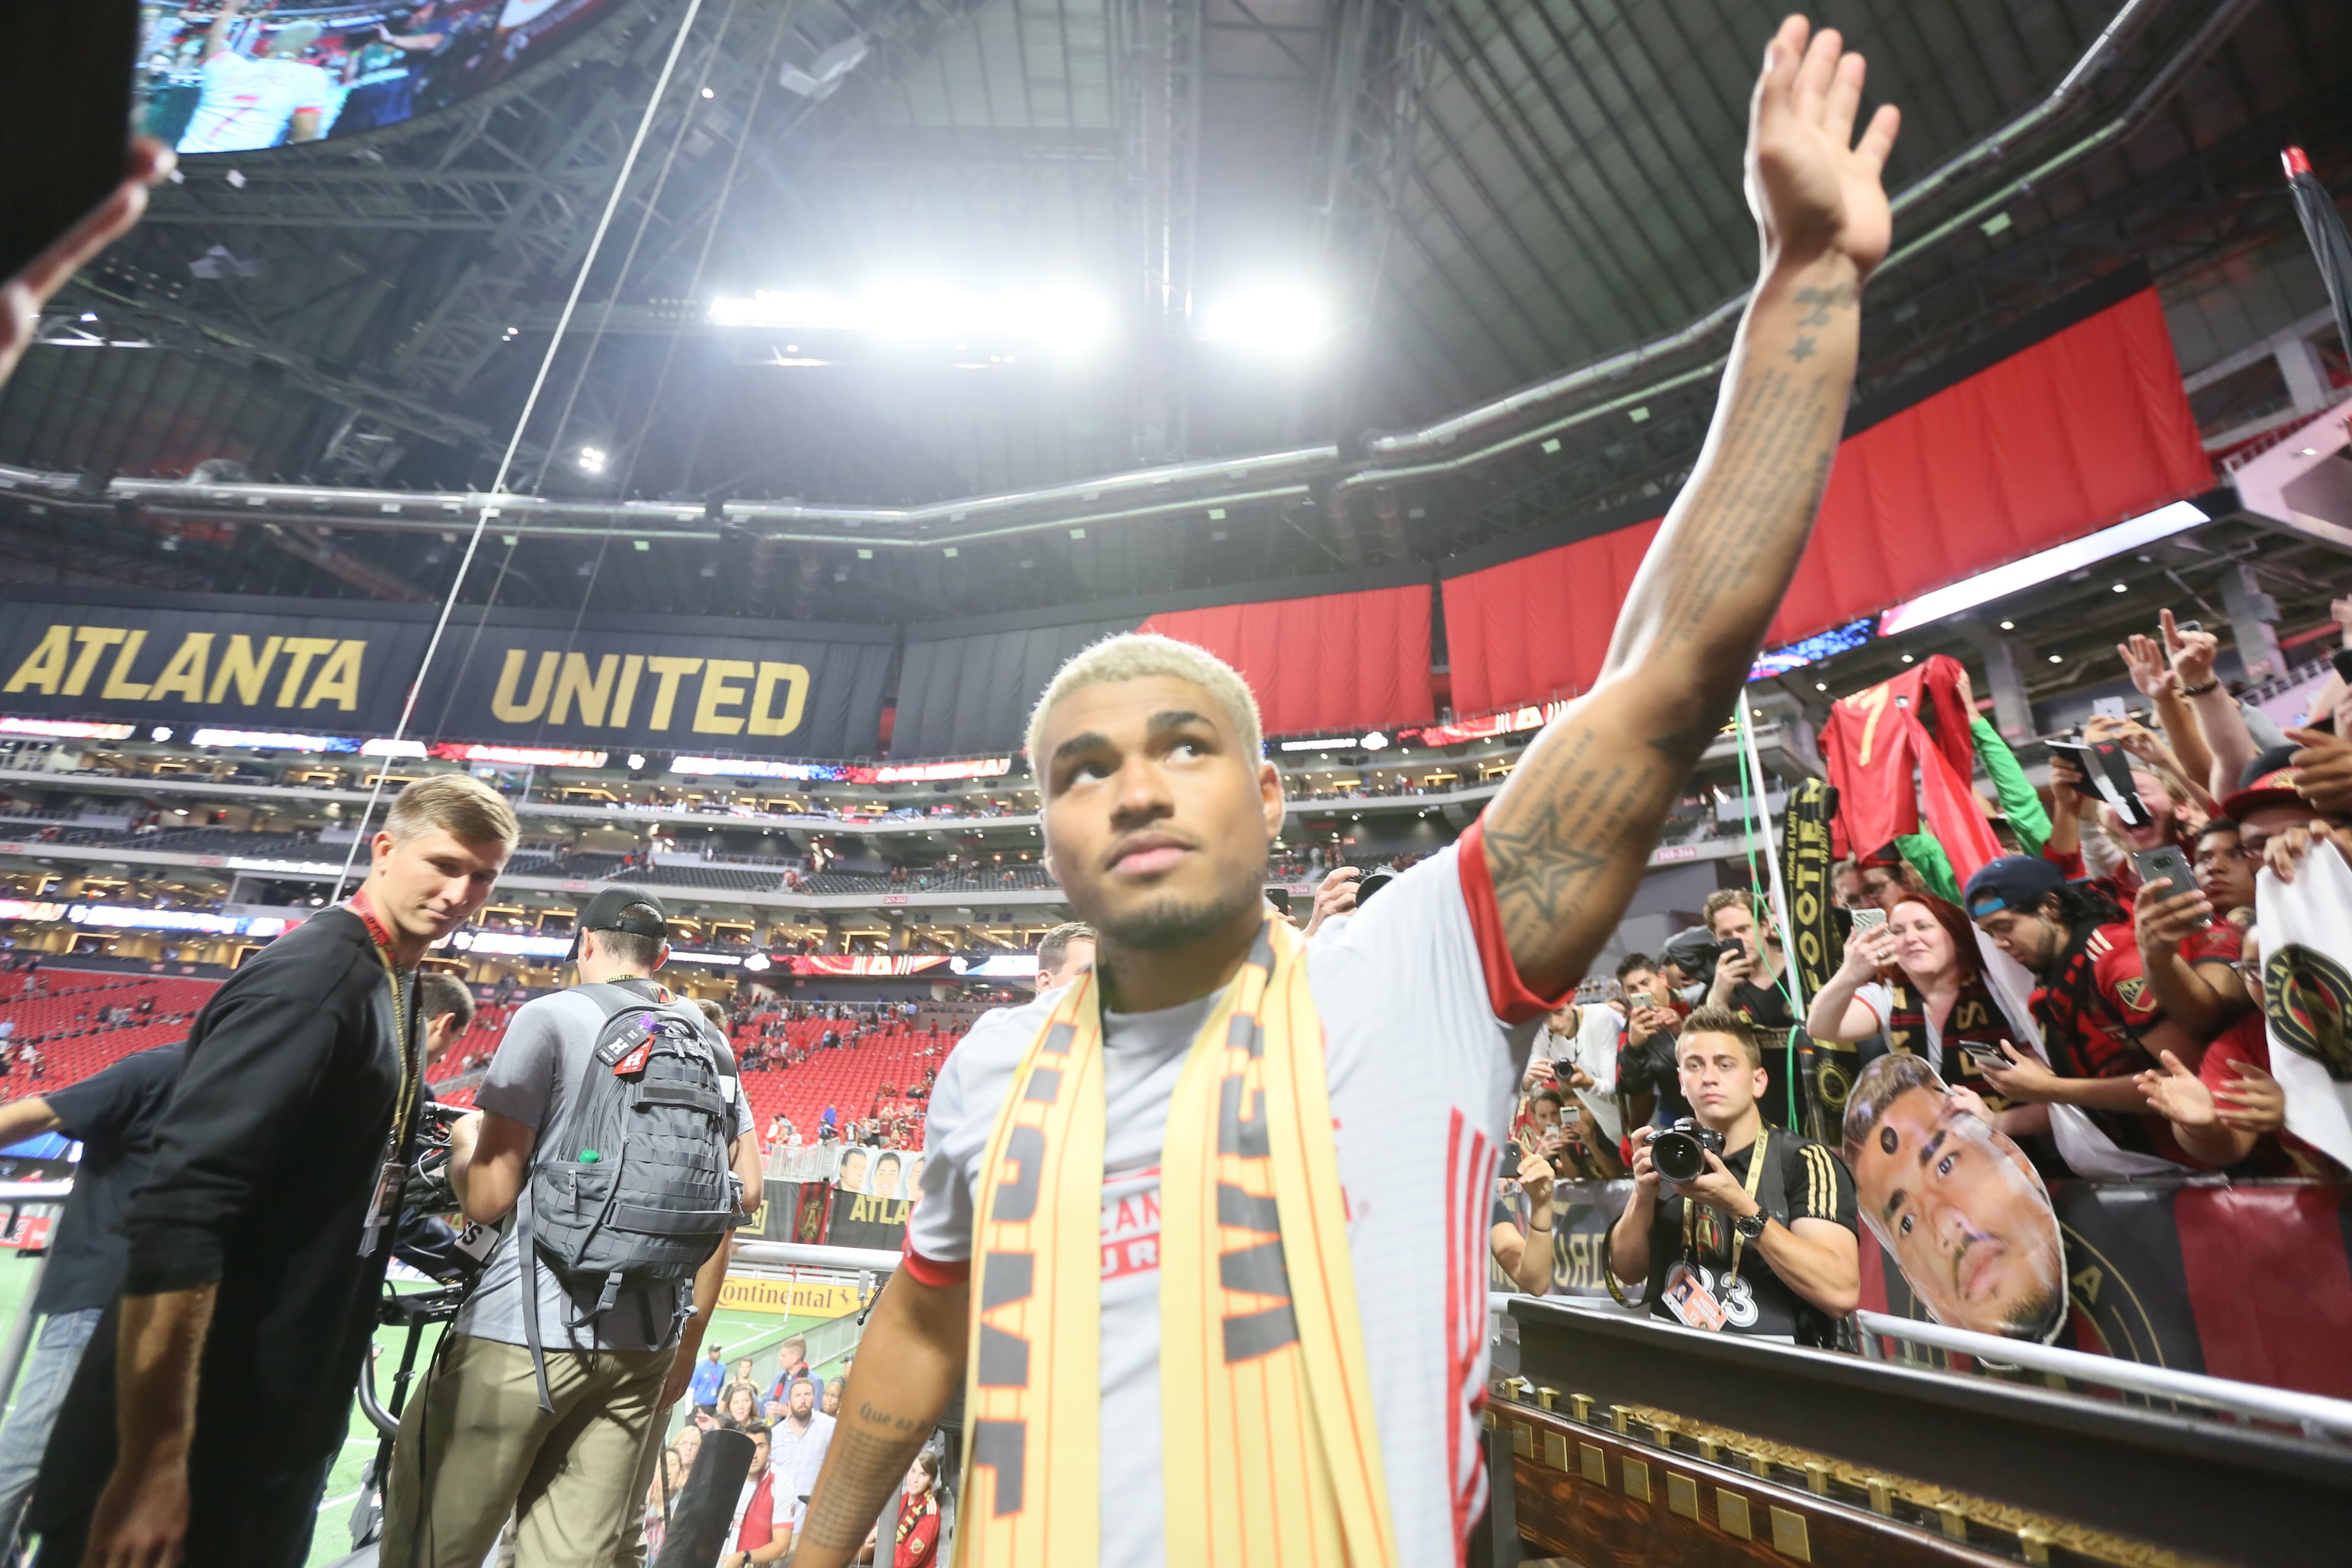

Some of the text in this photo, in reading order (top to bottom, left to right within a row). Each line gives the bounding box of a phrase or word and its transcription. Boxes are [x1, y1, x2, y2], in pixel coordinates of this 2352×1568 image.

[2, 625, 811, 737] ATLANTA UNITED
[1858, 681, 1890, 767] 7
